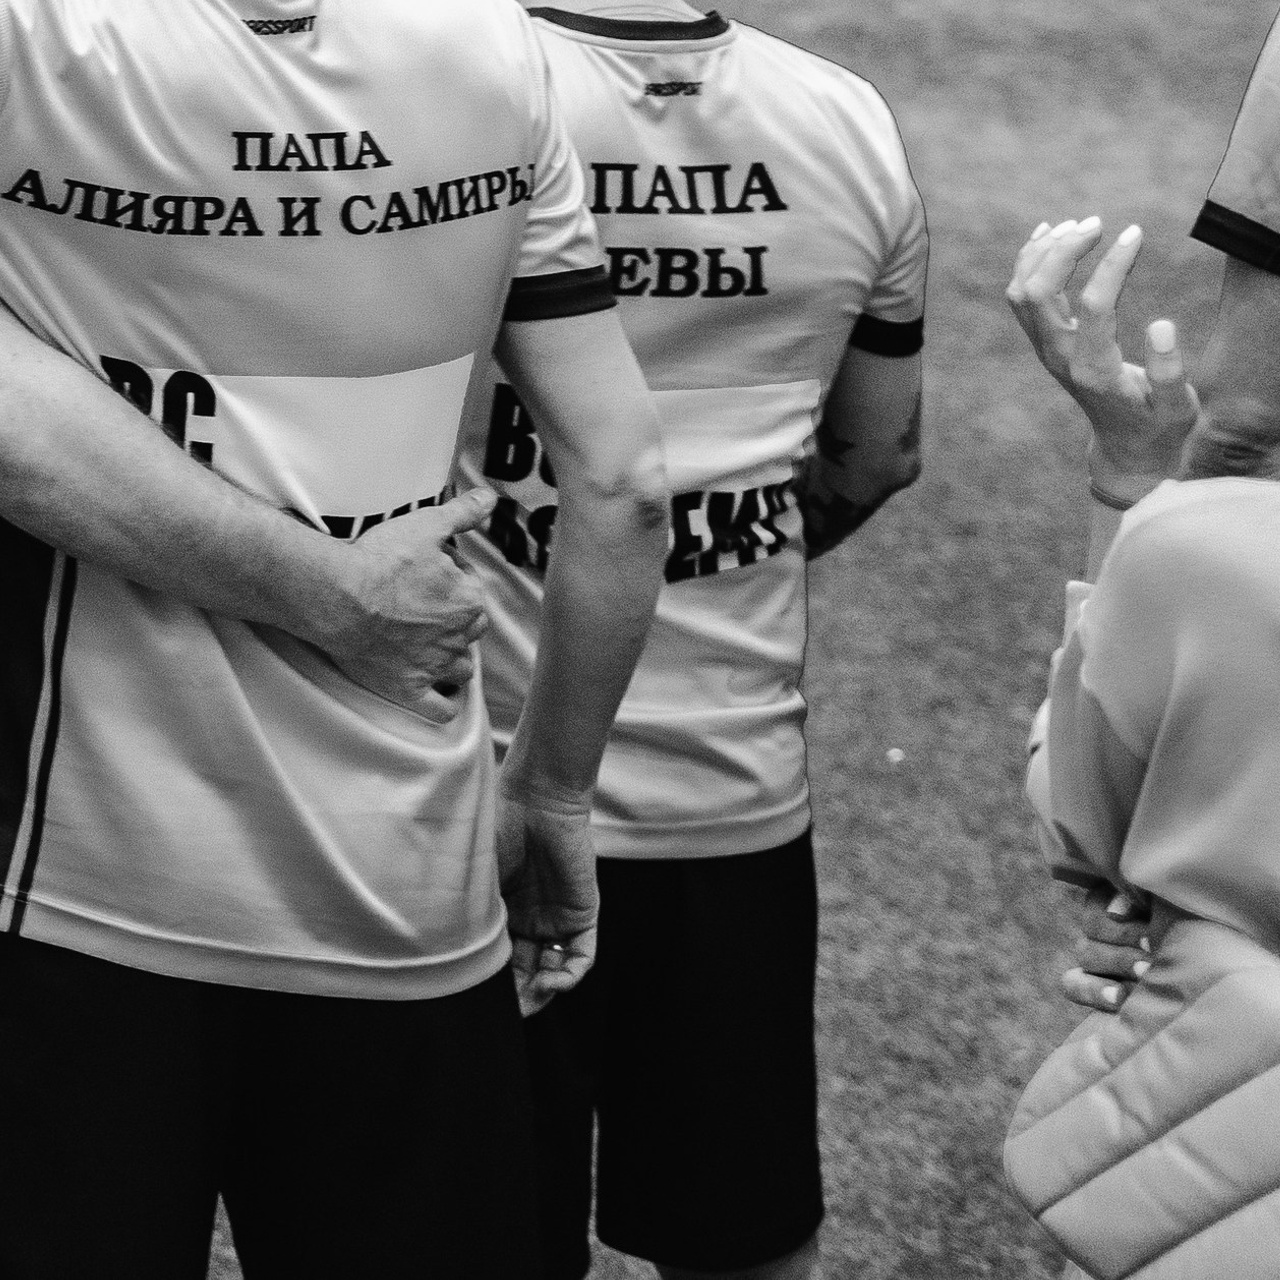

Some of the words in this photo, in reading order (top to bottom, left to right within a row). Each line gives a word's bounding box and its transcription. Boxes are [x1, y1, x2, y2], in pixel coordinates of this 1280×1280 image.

[231, 131, 393, 172] ПАПА
[1, 168, 265, 237] АЛИЯРА
[278, 197, 322, 237] И
[589, 161, 788, 215] ПАПА
[604, 245, 769, 298] ЕВЫ
